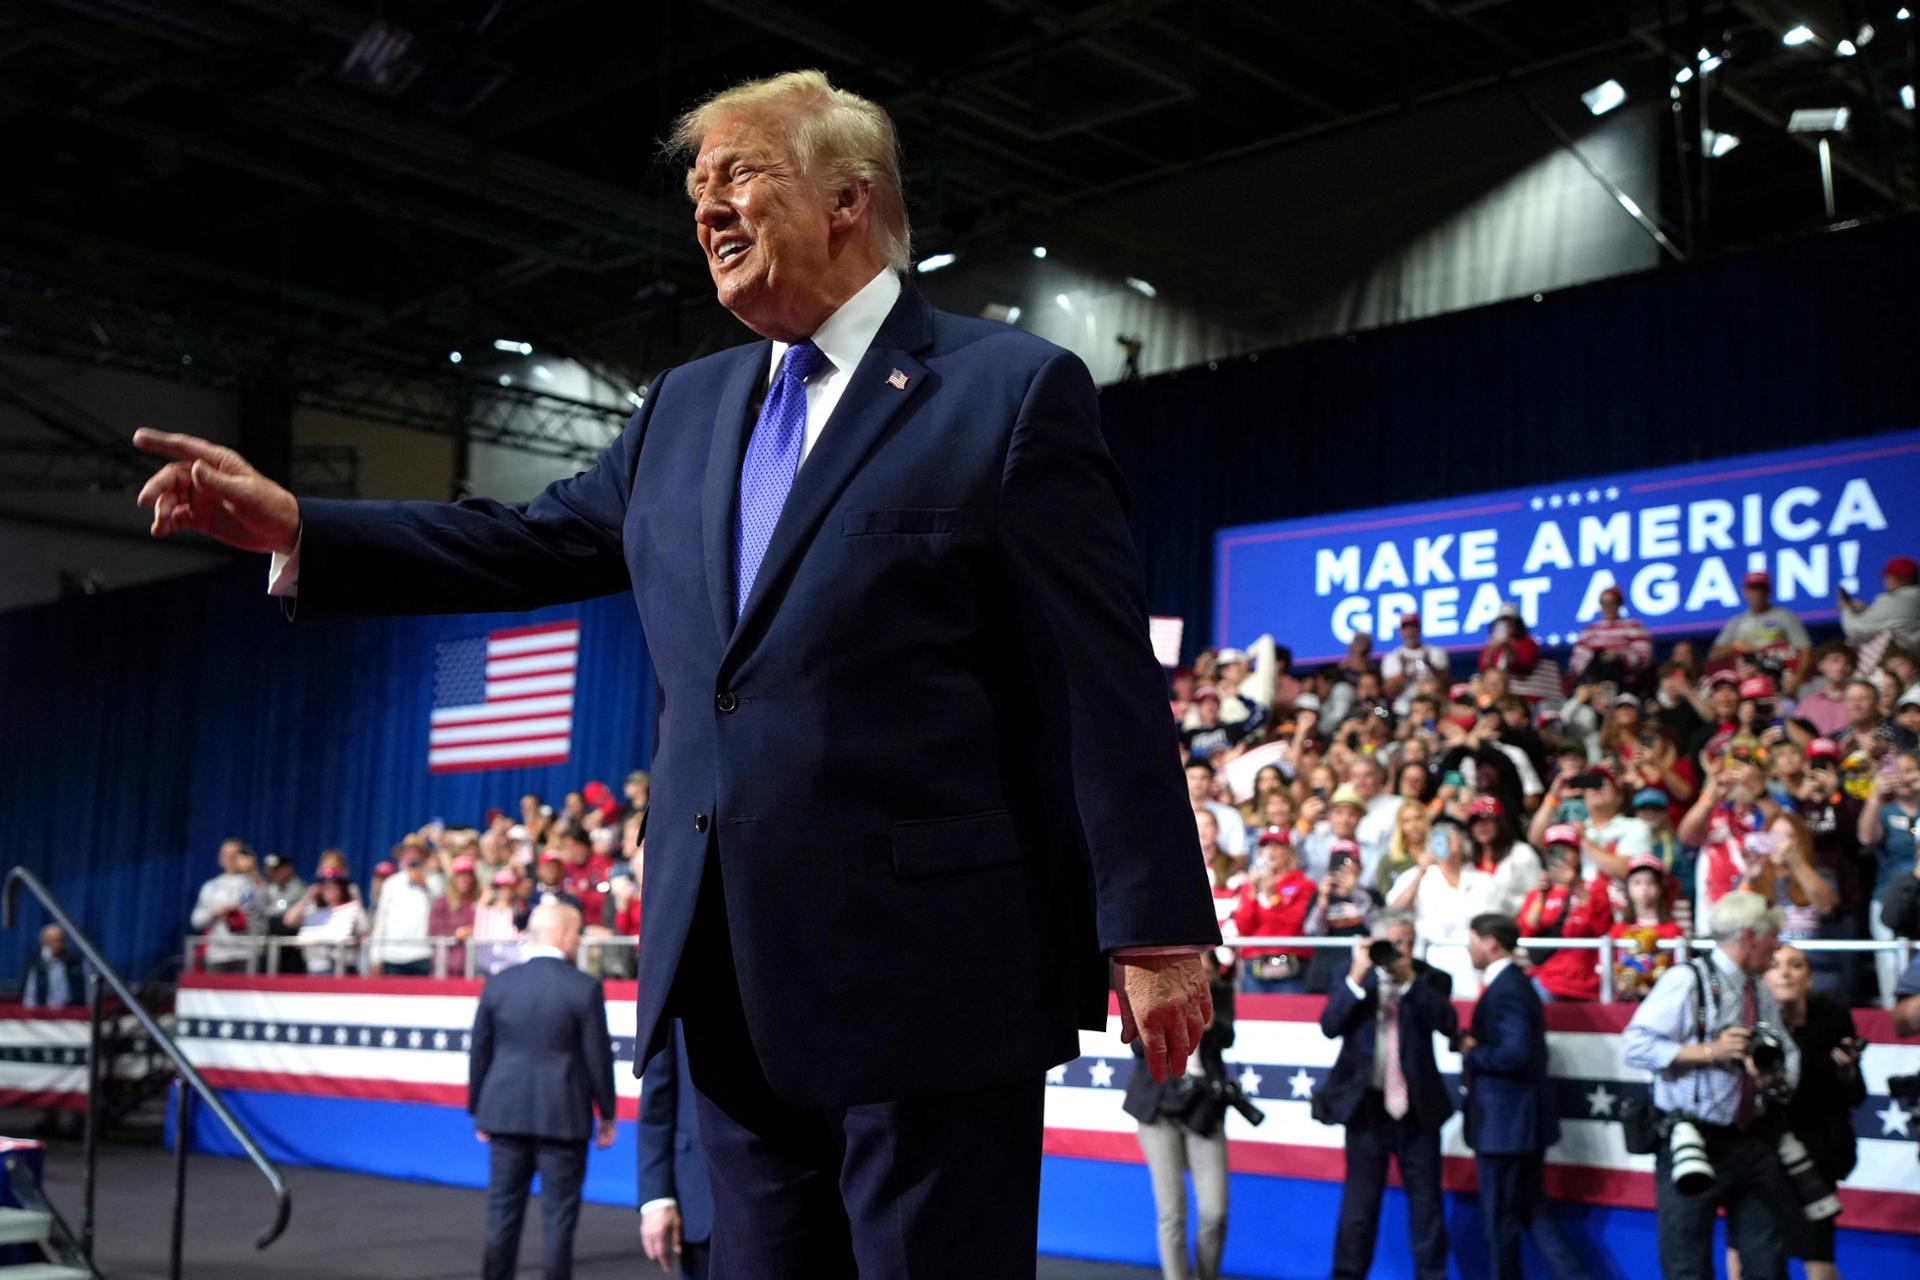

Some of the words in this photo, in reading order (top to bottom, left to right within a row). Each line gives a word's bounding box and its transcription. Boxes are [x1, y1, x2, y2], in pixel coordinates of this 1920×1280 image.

[1315, 528, 1499, 596] MAKE
[1522, 478, 1888, 573] AMERICA
[1331, 576, 1551, 645] GREAT
